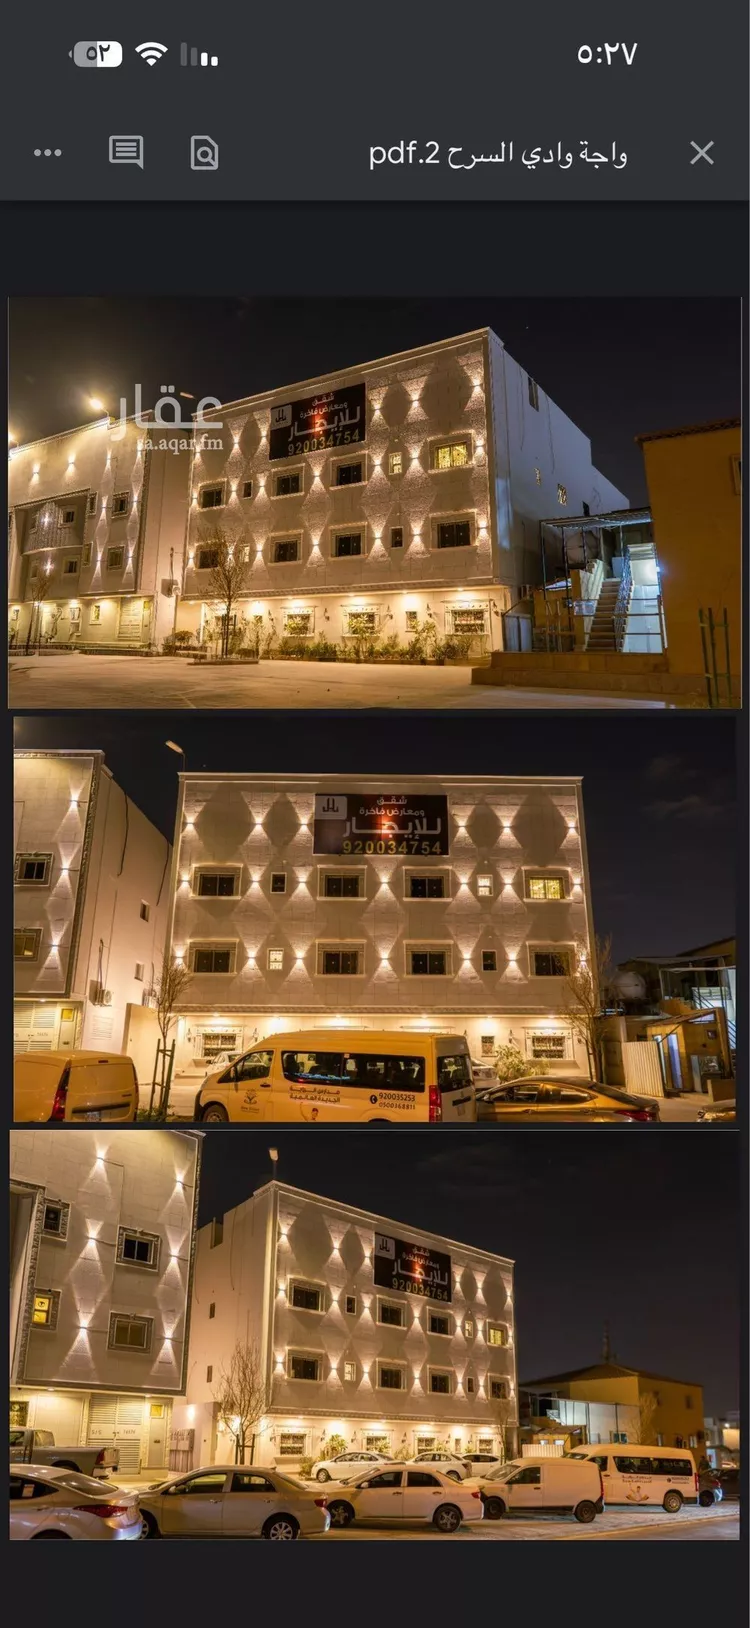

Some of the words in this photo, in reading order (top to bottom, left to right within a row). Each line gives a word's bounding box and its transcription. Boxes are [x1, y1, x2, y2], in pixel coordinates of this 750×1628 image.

[577, 42, 638, 66] ٥:٢٧
[447, 141, 513, 170] السرح
[521, 142, 573, 170] وادي
[579, 141, 628, 169] واجة
[288, 429, 360, 456] 920034754
[342, 840, 442, 855] 920034754
[379, 1092, 415, 1102] 920035253
